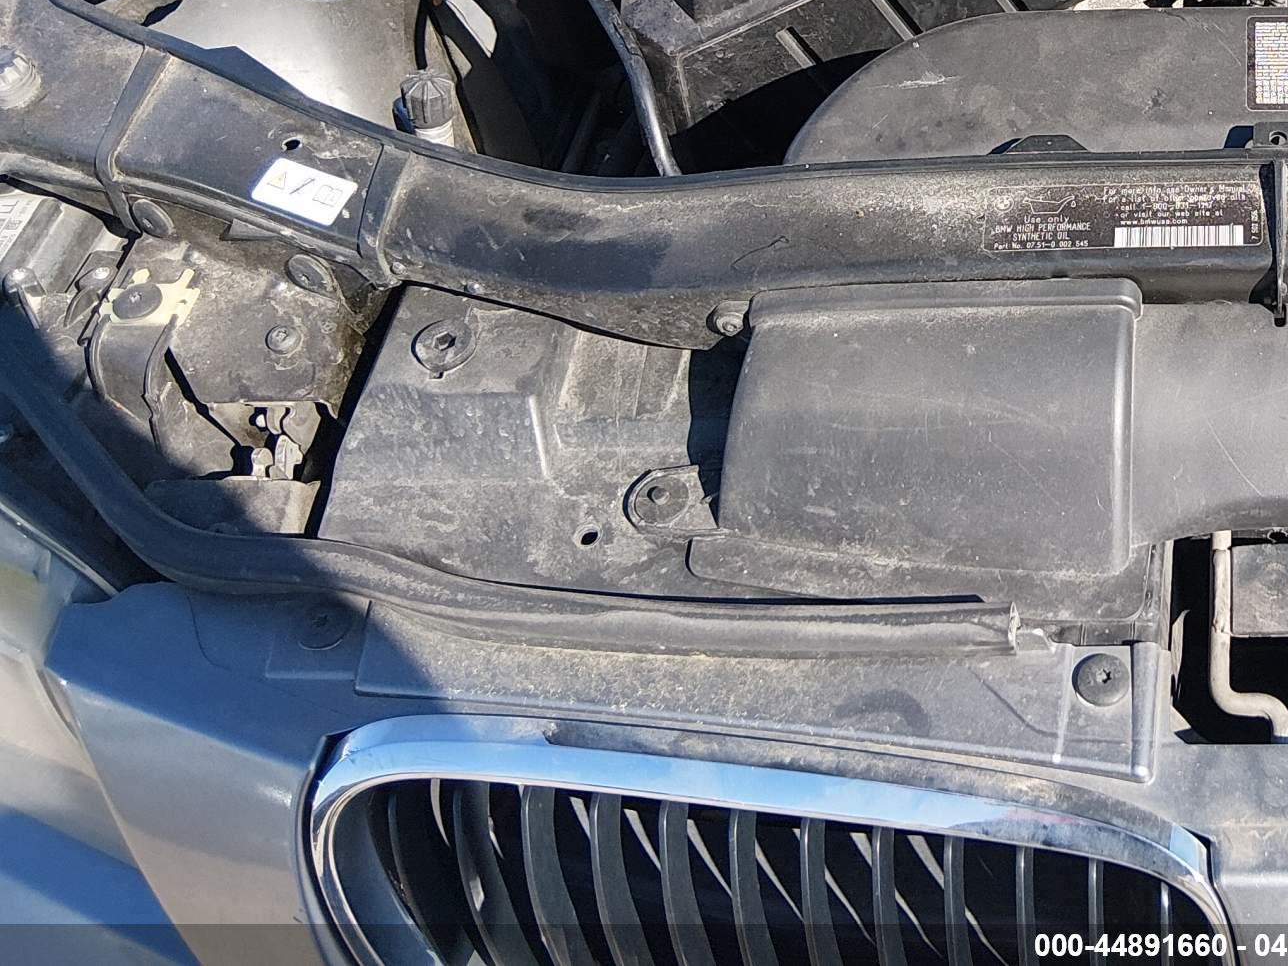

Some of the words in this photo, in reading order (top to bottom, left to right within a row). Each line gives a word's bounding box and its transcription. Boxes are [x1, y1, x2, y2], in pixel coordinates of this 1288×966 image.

[1024, 215, 1041, 224] Use
[1047, 214, 1069, 224] only
[995, 224, 1013, 234] BMW
[1016, 223, 1035, 233] HIGH
[1038, 221, 1091, 232] PERFORMANCE
[1012, 231, 1053, 242] SYNTHETIC
[1057, 231, 1070, 240] OIL
[993, 242, 1008, 250] Part
[1059, 240, 1072, 248] 002
[1075, 239, 1089, 247] 545
